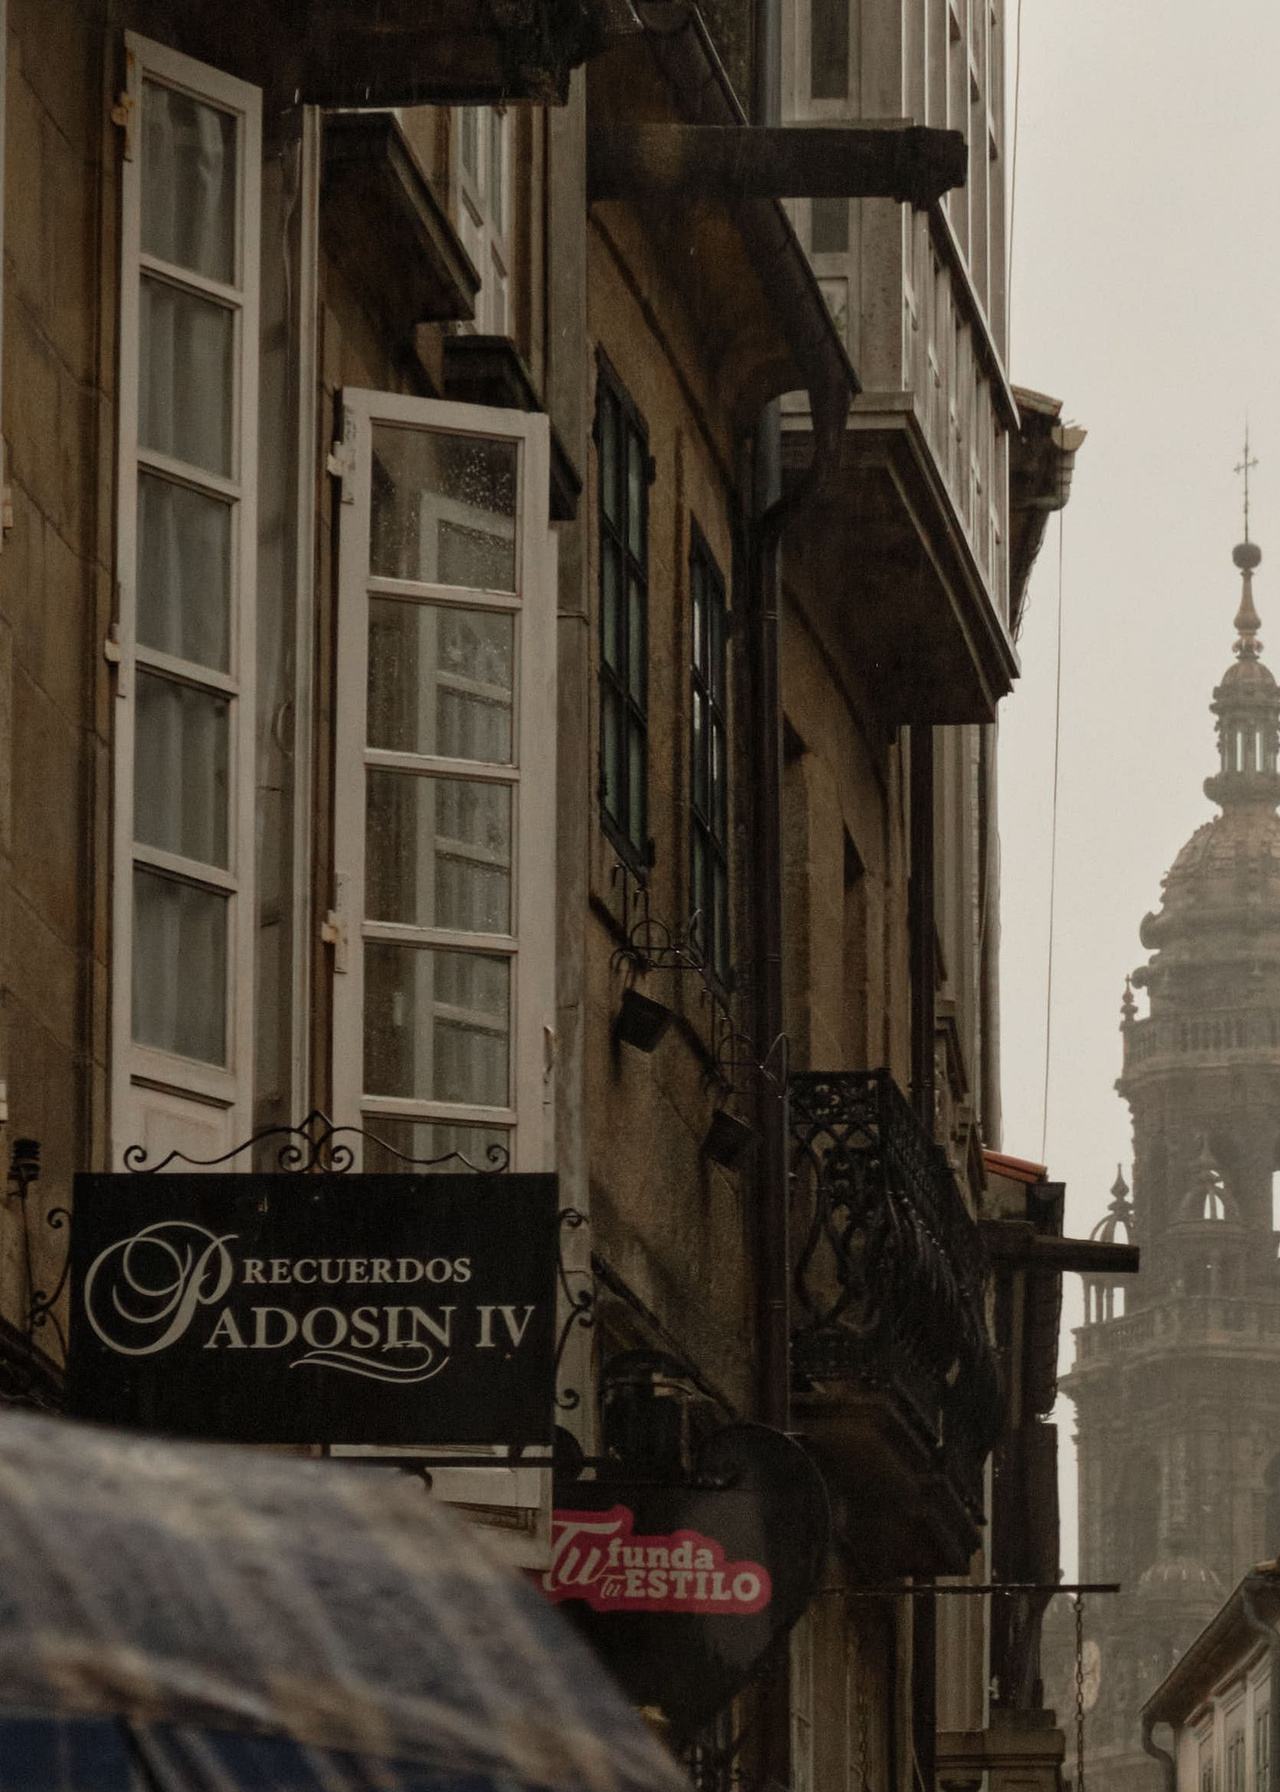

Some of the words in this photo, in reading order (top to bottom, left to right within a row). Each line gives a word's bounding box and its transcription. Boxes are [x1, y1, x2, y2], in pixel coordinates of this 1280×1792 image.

[84, 1221, 454, 1362] PADOSIN
[476, 1304, 536, 1349] IV
[243, 1257, 471, 1285] RECUERDOS
[543, 1519, 622, 1592] Tu
[606, 1537, 715, 1570] funda
[624, 1569, 761, 1602] ESTILO
